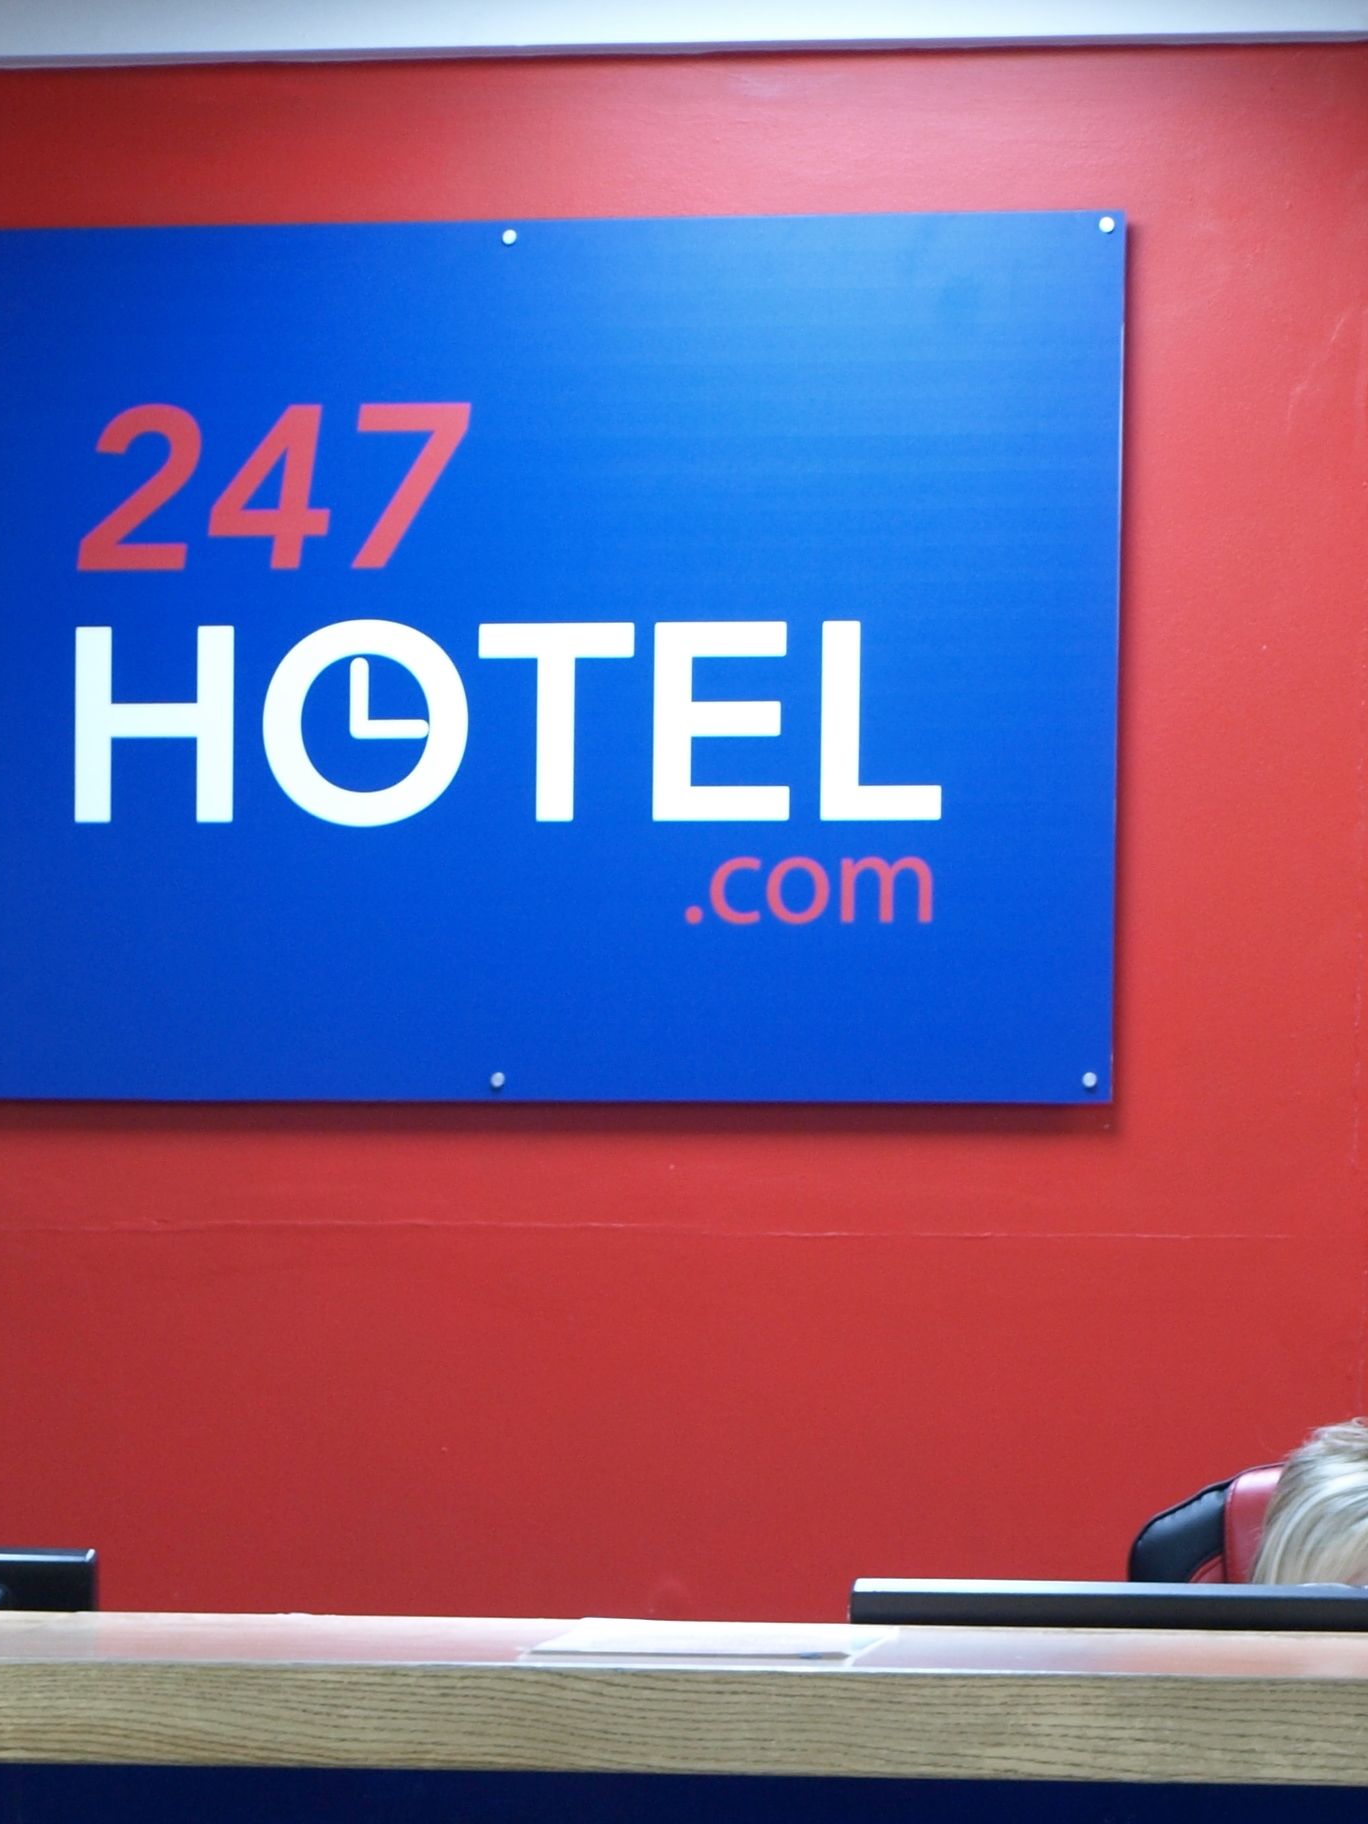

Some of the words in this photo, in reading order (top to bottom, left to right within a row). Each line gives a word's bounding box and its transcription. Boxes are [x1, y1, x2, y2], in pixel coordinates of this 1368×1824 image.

[76, 402, 472, 571] 247
[74, 619, 943, 827] HOTEL
[685, 855, 934, 925] .com
